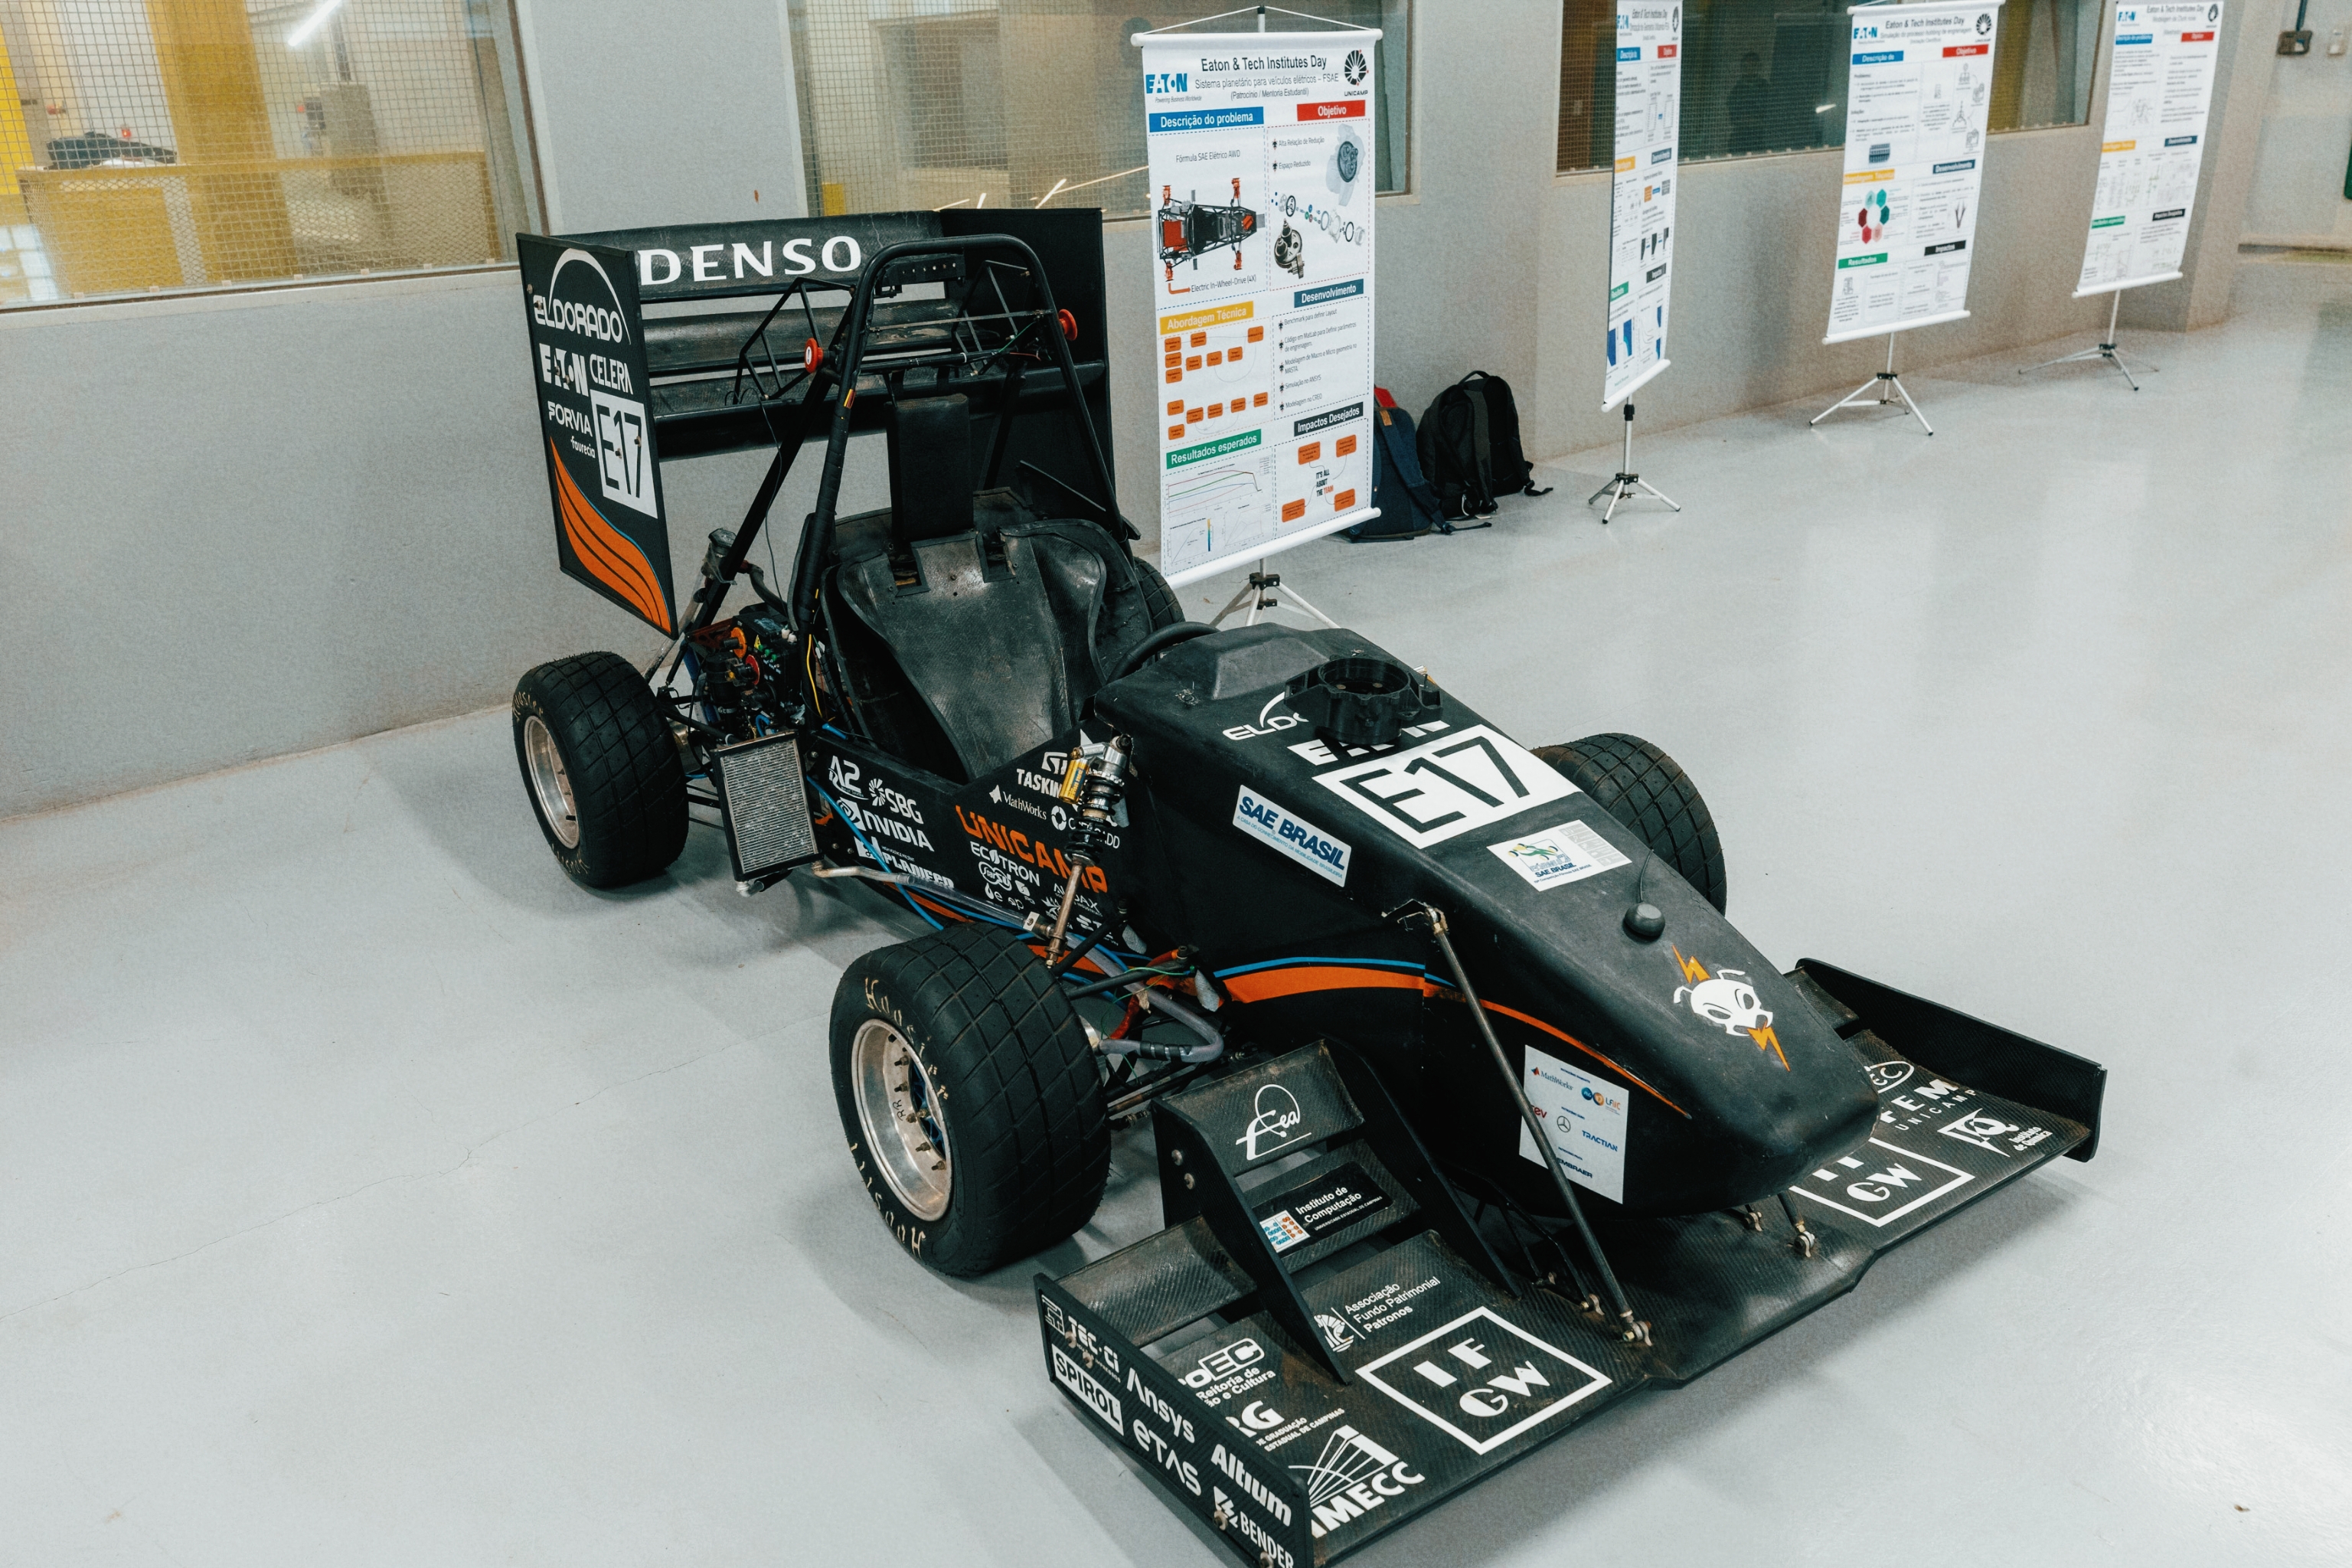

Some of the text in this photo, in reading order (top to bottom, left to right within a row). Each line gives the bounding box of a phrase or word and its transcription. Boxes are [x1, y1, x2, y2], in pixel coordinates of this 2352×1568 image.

[1886, 20, 1903, 29] Eaton
[1926, 18, 1952, 26] Institutes
[1953, 16, 1965, 26] Day
[1201, 54, 1327, 72] Eaton & Tech Institutes Day
[1145, 73, 1187, 94] EATON
[1194, 73, 1339, 90] Sistema planetário para veículos elétricos FSAE
[1230, 87, 1309, 101] (Patrocínio Mentoria Estudantil)
[1161, 111, 1253, 129] Descrição do problema
[1318, 106, 1347, 117] Objetivo
[1287, 139, 1302, 147] Relação
[1308, 136, 1325, 145] Redução
[1176, 149, 1240, 163] Fórmula SAE Elétrico AWD
[637, 236, 862, 286] DENSO
[1848, 256, 1877, 266] Resultados
[1191, 283, 1210, 292] Electric
[1210, 277, 1246, 289] In-Wheel-Drive
[1302, 284, 1357, 303] Desenvolvimento
[533, 295, 622, 343] ELDORADO
[1168, 308, 1246, 330] Abordagem Técnica
[1285, 315, 1305, 325] Benchmark
[1326, 309, 1337, 318] Layout
[1285, 335, 1297, 344] Código
[539, 343, 633, 397] EATON CELERA
[1285, 356, 1305, 365] Modelagem
[1285, 378, 1303, 389] Simulação
[1309, 374, 1321, 383] ANSYS
[1285, 399, 1307, 410] Modelagem
[547, 400, 593, 437] FORVIA
[1298, 407, 1360, 433] Impactos Desejados
[570, 436, 596, 459] faurecia
[596, 403, 642, 499] E17
[1171, 434, 1257, 465] Resultados esperados
[1316, 479, 1328, 488] ABOUT
[1324, 485, 1334, 495] TEAM
[1017, 768, 1062, 799] TASKIN
[1339, 735, 1530, 835] E17
[885, 788, 924, 825] SBG
[1003, 791, 1047, 821] MathWorks
[1240, 796, 1345, 871] SAE BRASIL
[970, 841, 1040, 887] ECOTRON
[1257, 826, 1288, 848] CONHECIMENTO
[1295, 848, 1318, 866] MOBILIDADE
[1319, 862, 1343, 879] BRASILEIRA
[1550, 863, 1576, 874] BRASIL
[1540, 1070, 1573, 1091] MathWorks
[1894, 1089, 1977, 1131] UNICAMP
[1582, 1130, 1618, 1152] TRACTIAN
[1295, 1187, 1348, 1215] Instituto de
[1304, 1193, 1362, 1223] Computação
[1344, 1282, 1400, 1315] Associação
[1353, 1276, 1441, 1324] Fundo Patrimonial
[1363, 1305, 1413, 1334] Patronos
[1231, 1370, 1276, 1395] Cultura
[1243, 1367, 1260, 1379] de
[1054, 1352, 1120, 1426] SPIROL
[1459, 1360, 1550, 1417] GW
[1126, 1367, 1195, 1444] Ansys
[1263, 1407, 1345, 1452] ESTADUAL DE CAMPINAS
[1265, 1416, 1308, 1442] GRADUAÇÃO
[1210, 1443, 1292, 1528] Altium
[1240, 1511, 1294, 1568] BENDER
